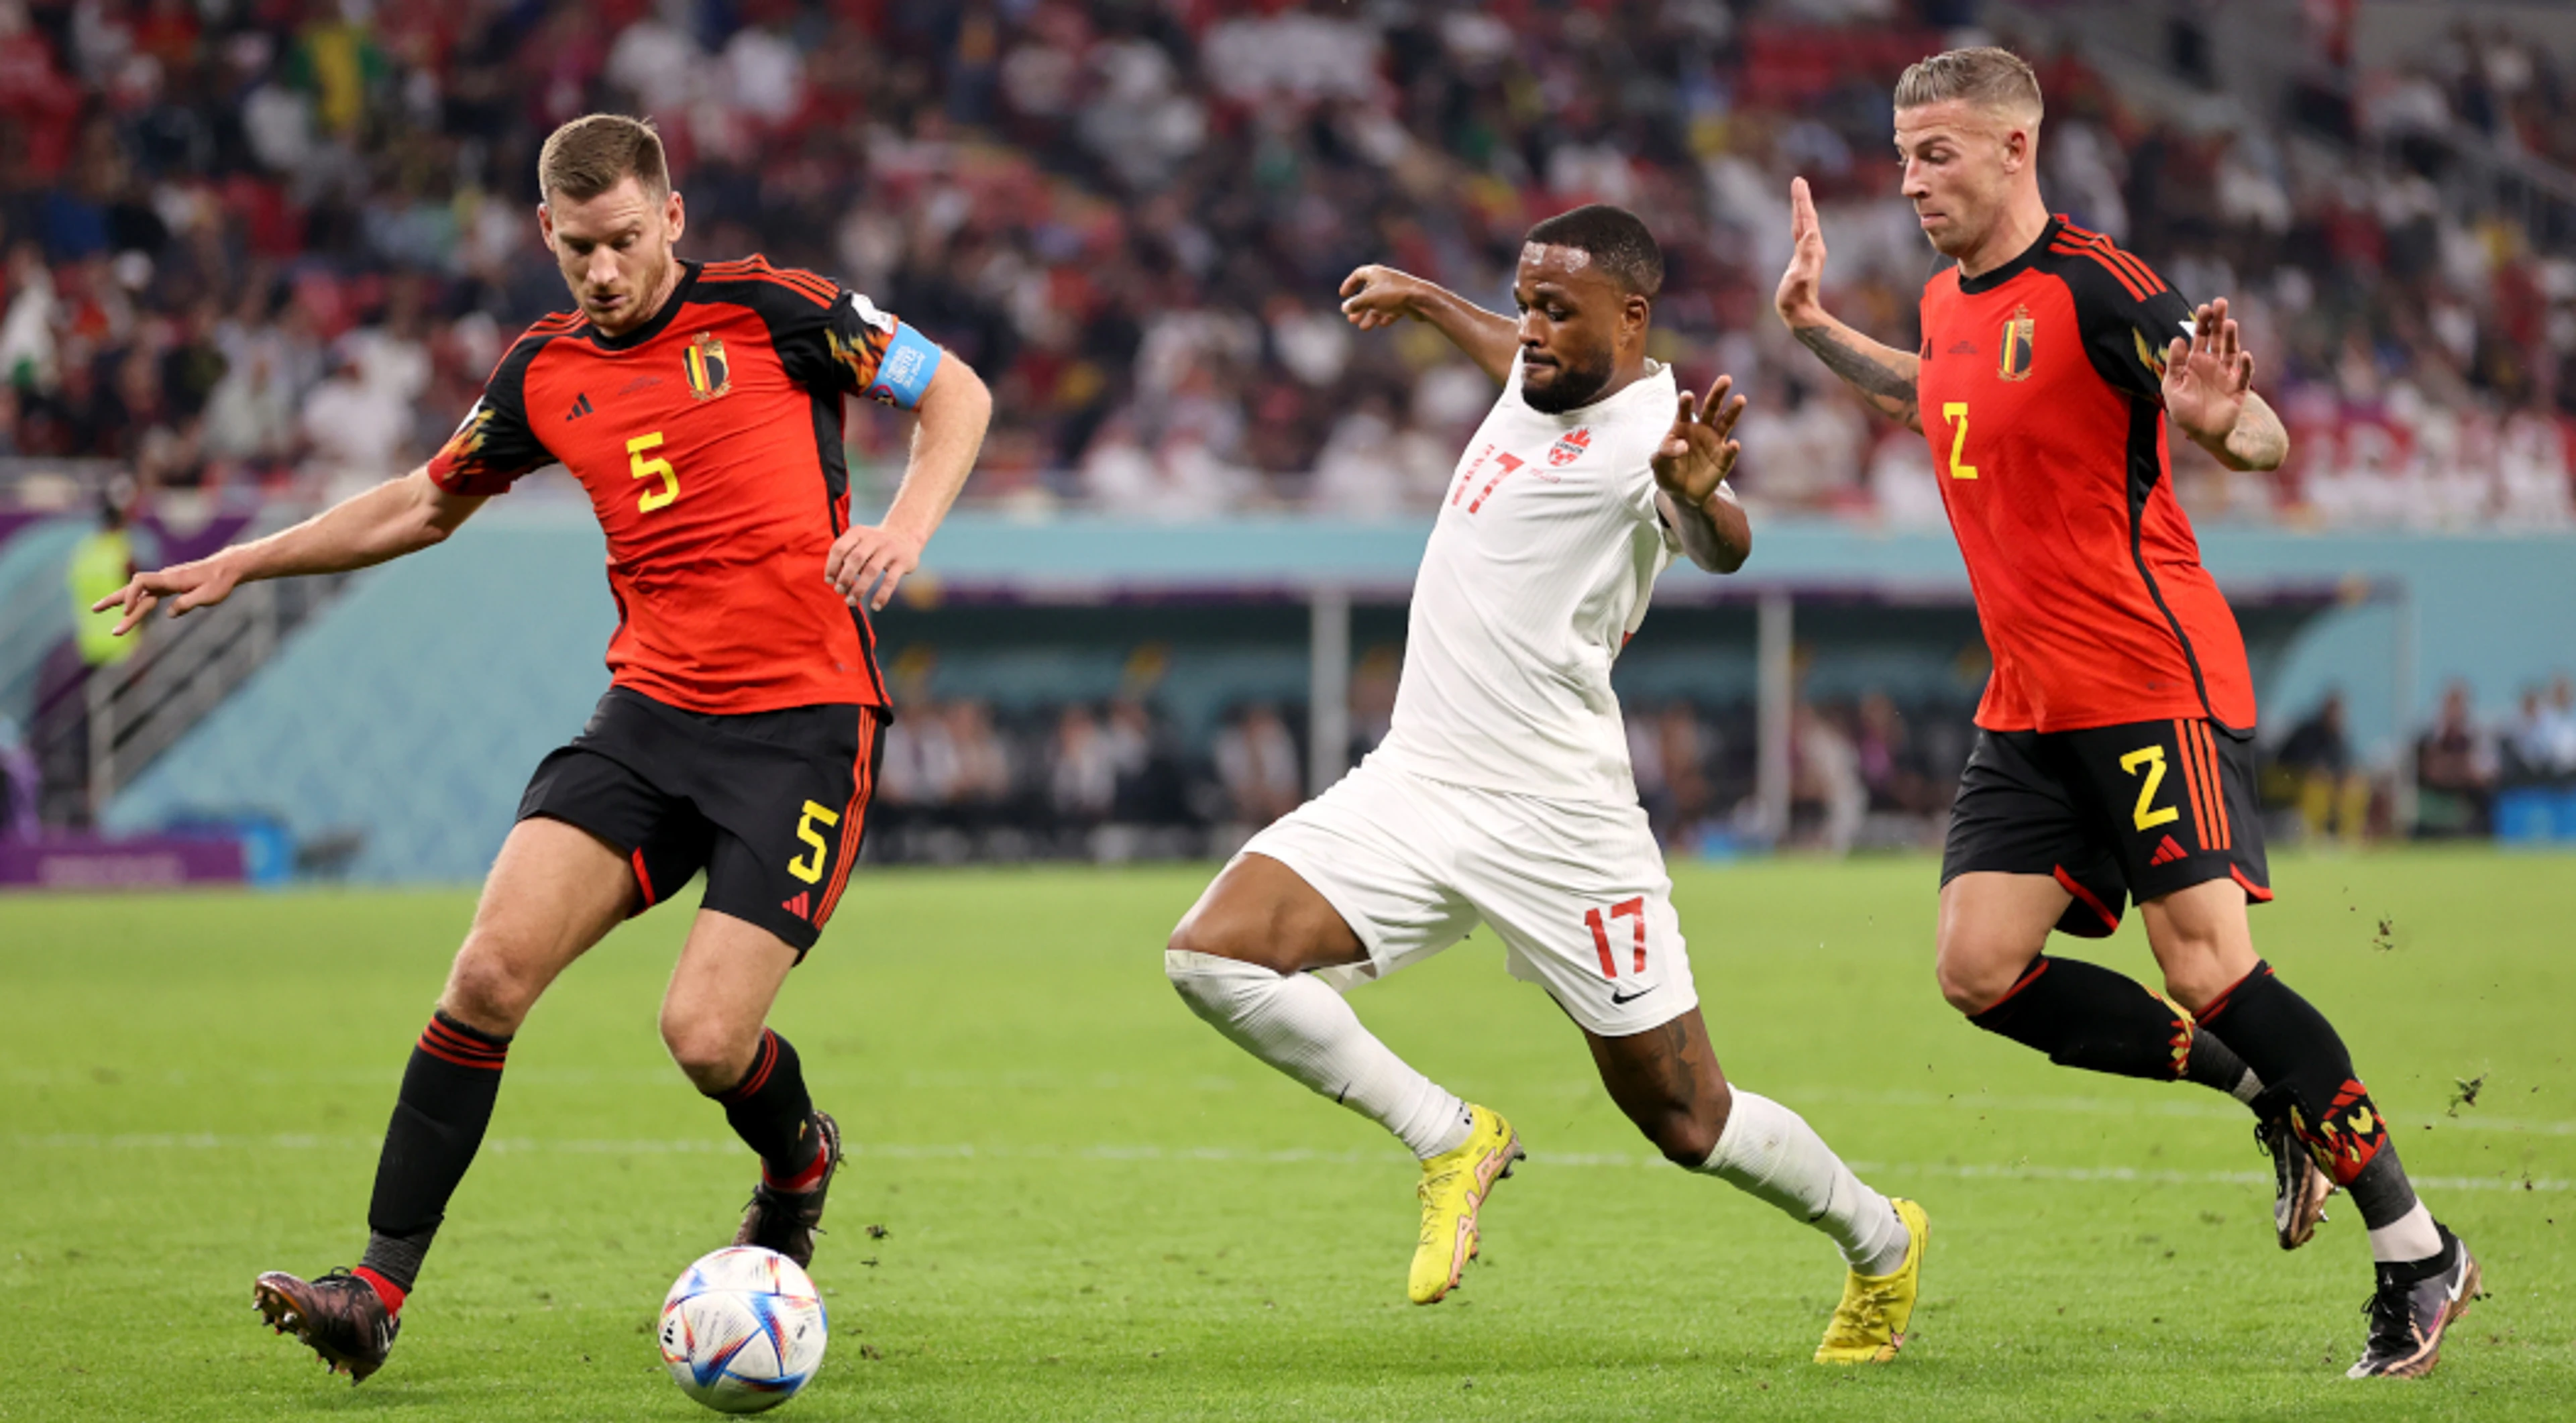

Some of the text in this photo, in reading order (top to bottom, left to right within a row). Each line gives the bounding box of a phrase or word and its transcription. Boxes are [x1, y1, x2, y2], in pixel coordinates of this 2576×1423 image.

[625, 431, 680, 513] 5
[1943, 402, 1978, 479] 2
[2119, 744, 2180, 832] 2
[787, 799, 839, 885] 5
[1585, 896, 1647, 980] 17
